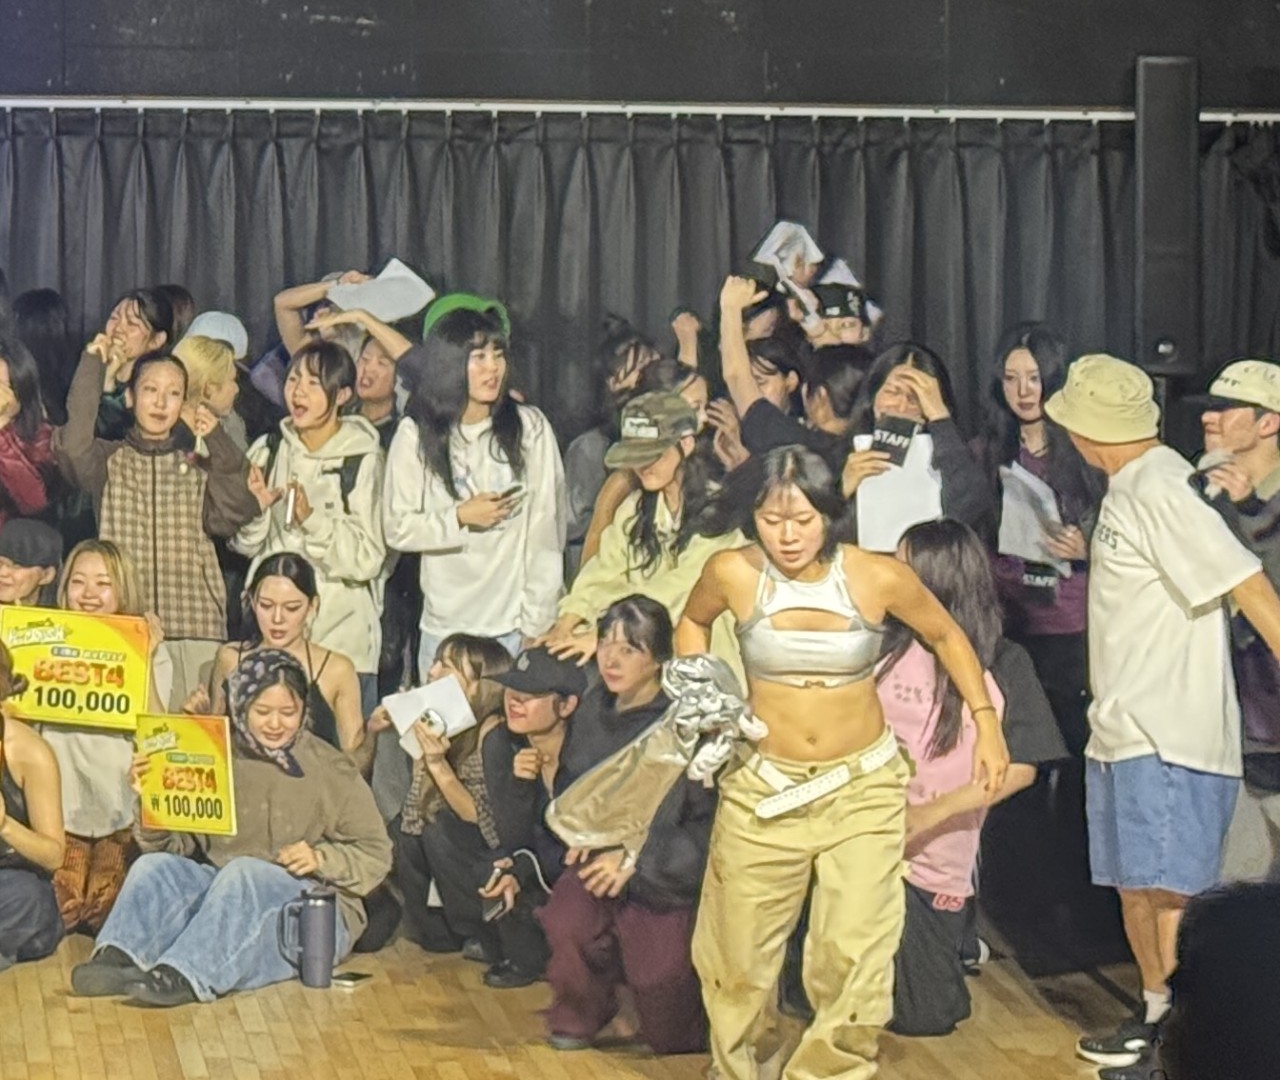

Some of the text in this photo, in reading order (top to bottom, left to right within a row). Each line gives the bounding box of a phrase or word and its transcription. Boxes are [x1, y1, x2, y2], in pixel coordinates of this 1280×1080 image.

[874, 429, 911, 449] STAFF
[33, 658, 125, 689] BEST4
[33, 686, 130, 714] 100,000
[162, 766, 217, 794] BEST4
[164, 794, 223, 822] 100,000
